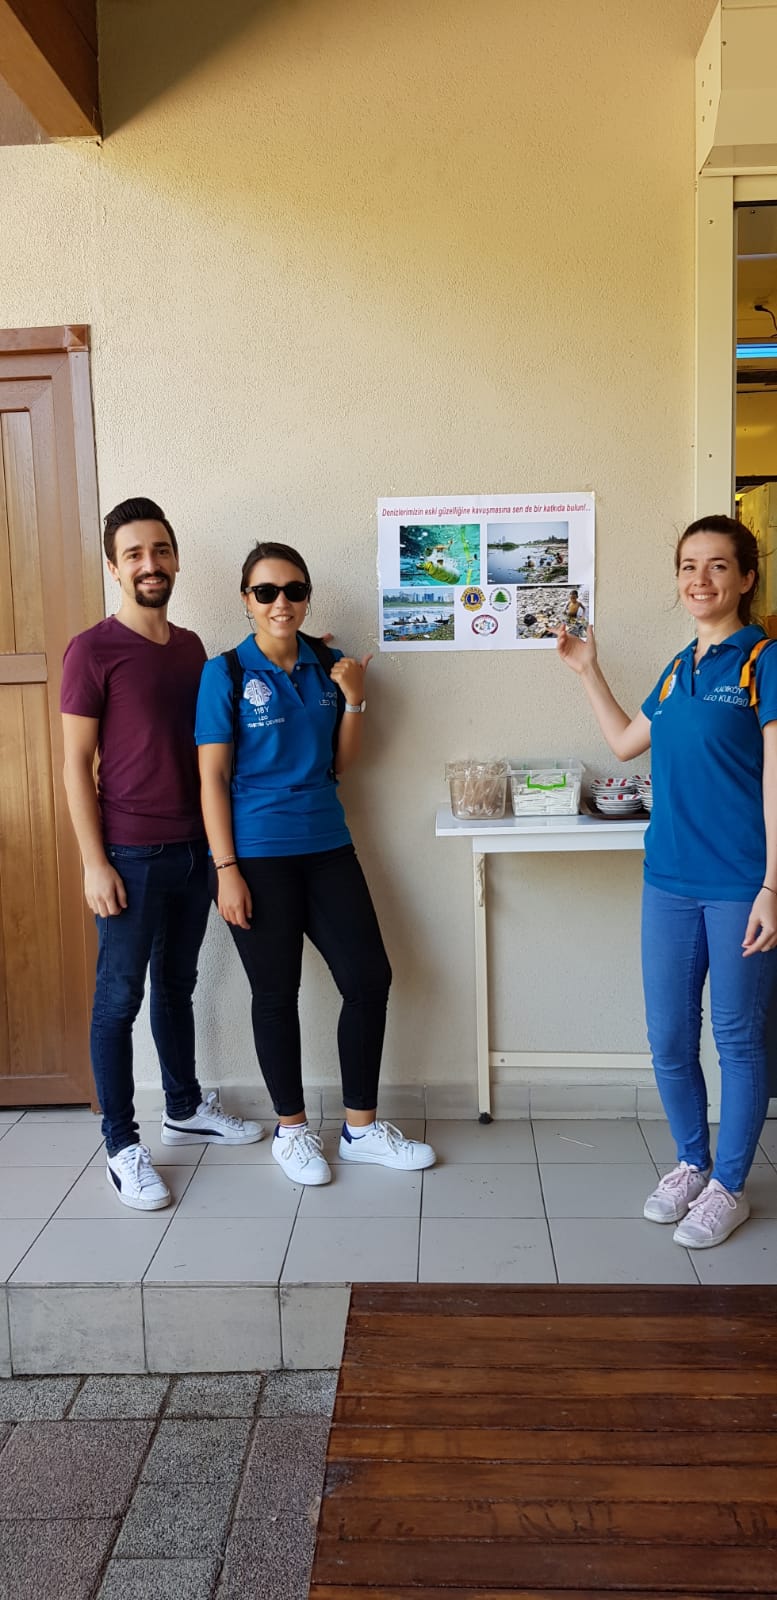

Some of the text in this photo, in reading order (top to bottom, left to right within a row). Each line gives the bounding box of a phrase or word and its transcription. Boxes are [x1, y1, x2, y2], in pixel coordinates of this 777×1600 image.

[382, 508, 424, 517] Denizlerimizin
[425, 507, 437, 515] eski
[438, 506, 470, 517] güzelliğine
[525, 505, 532, 513] de
[534, 504, 543, 512] bir
[544, 504, 565, 513] katkıda
[704, 694, 717, 702] LEO
